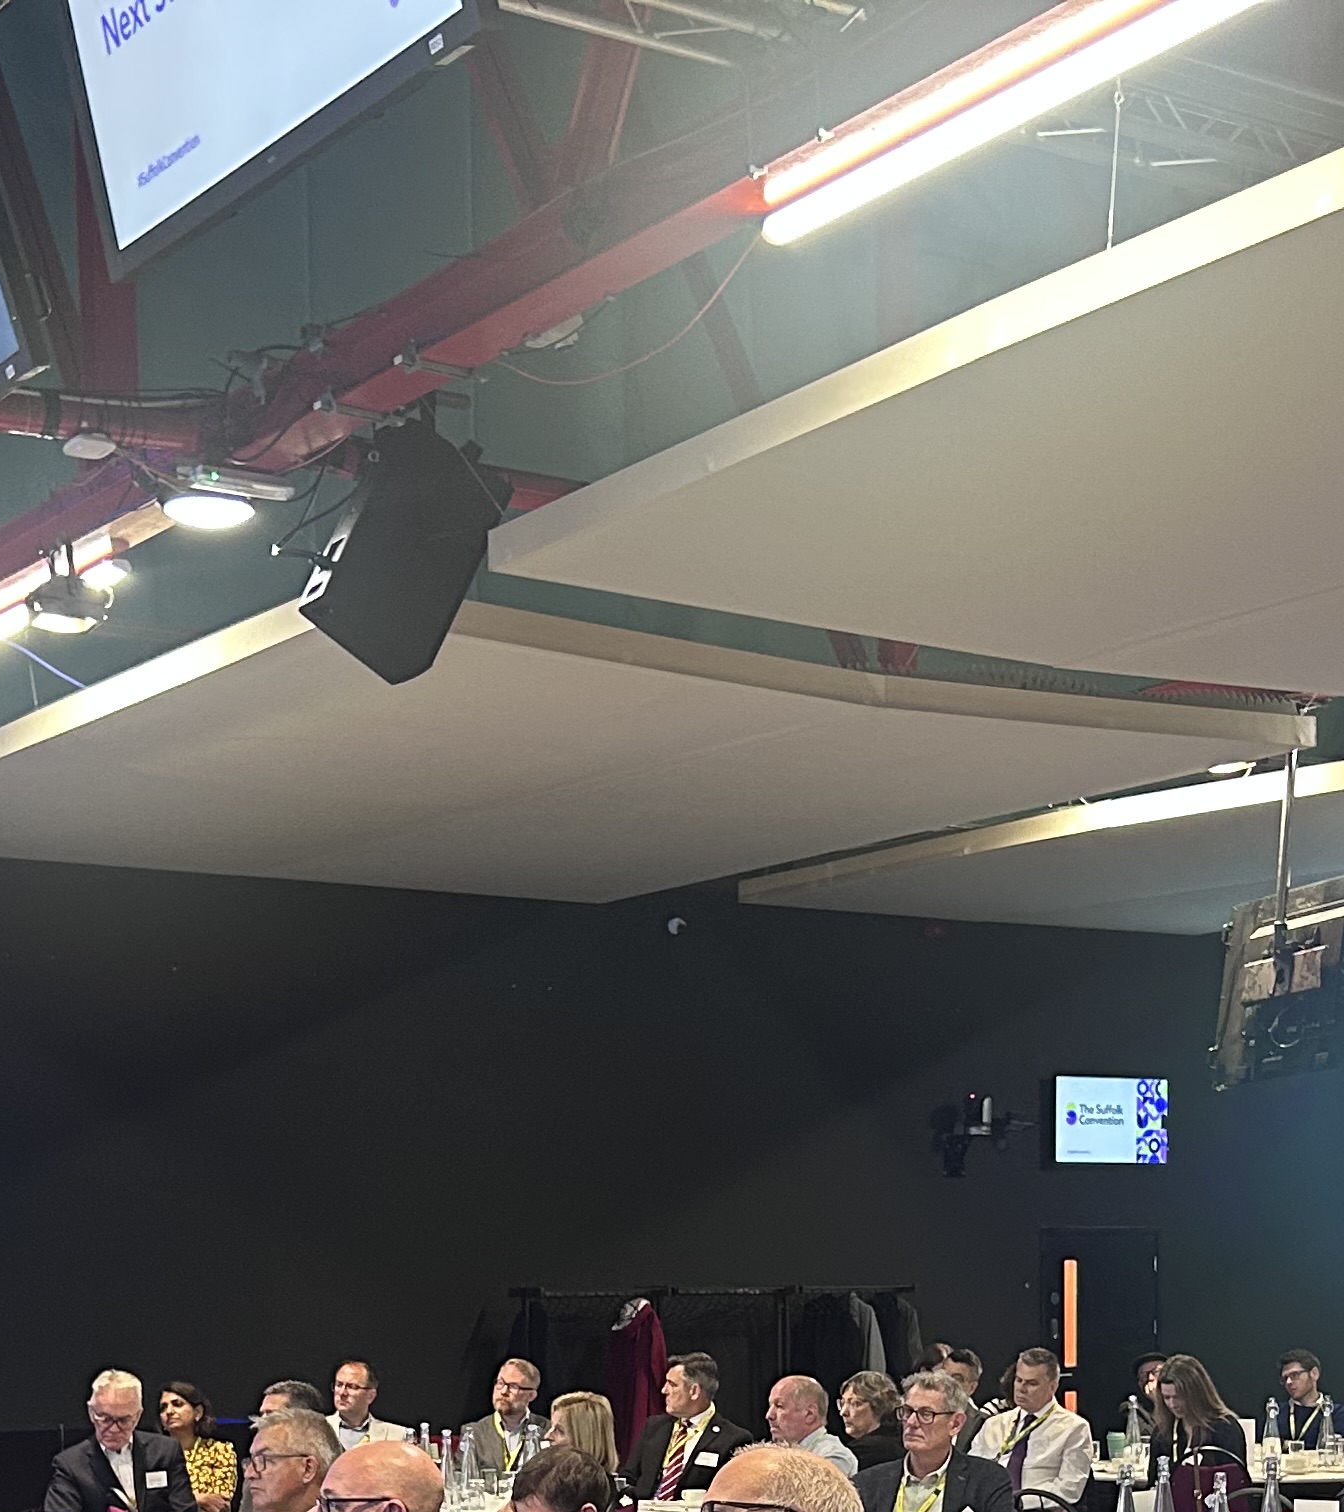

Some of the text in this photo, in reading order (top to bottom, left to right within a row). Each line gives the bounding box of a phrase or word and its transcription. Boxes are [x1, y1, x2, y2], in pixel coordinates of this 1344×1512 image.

[1079, 1103, 1123, 1116] The Suffolk
[1079, 1115, 1124, 1126] Convention
